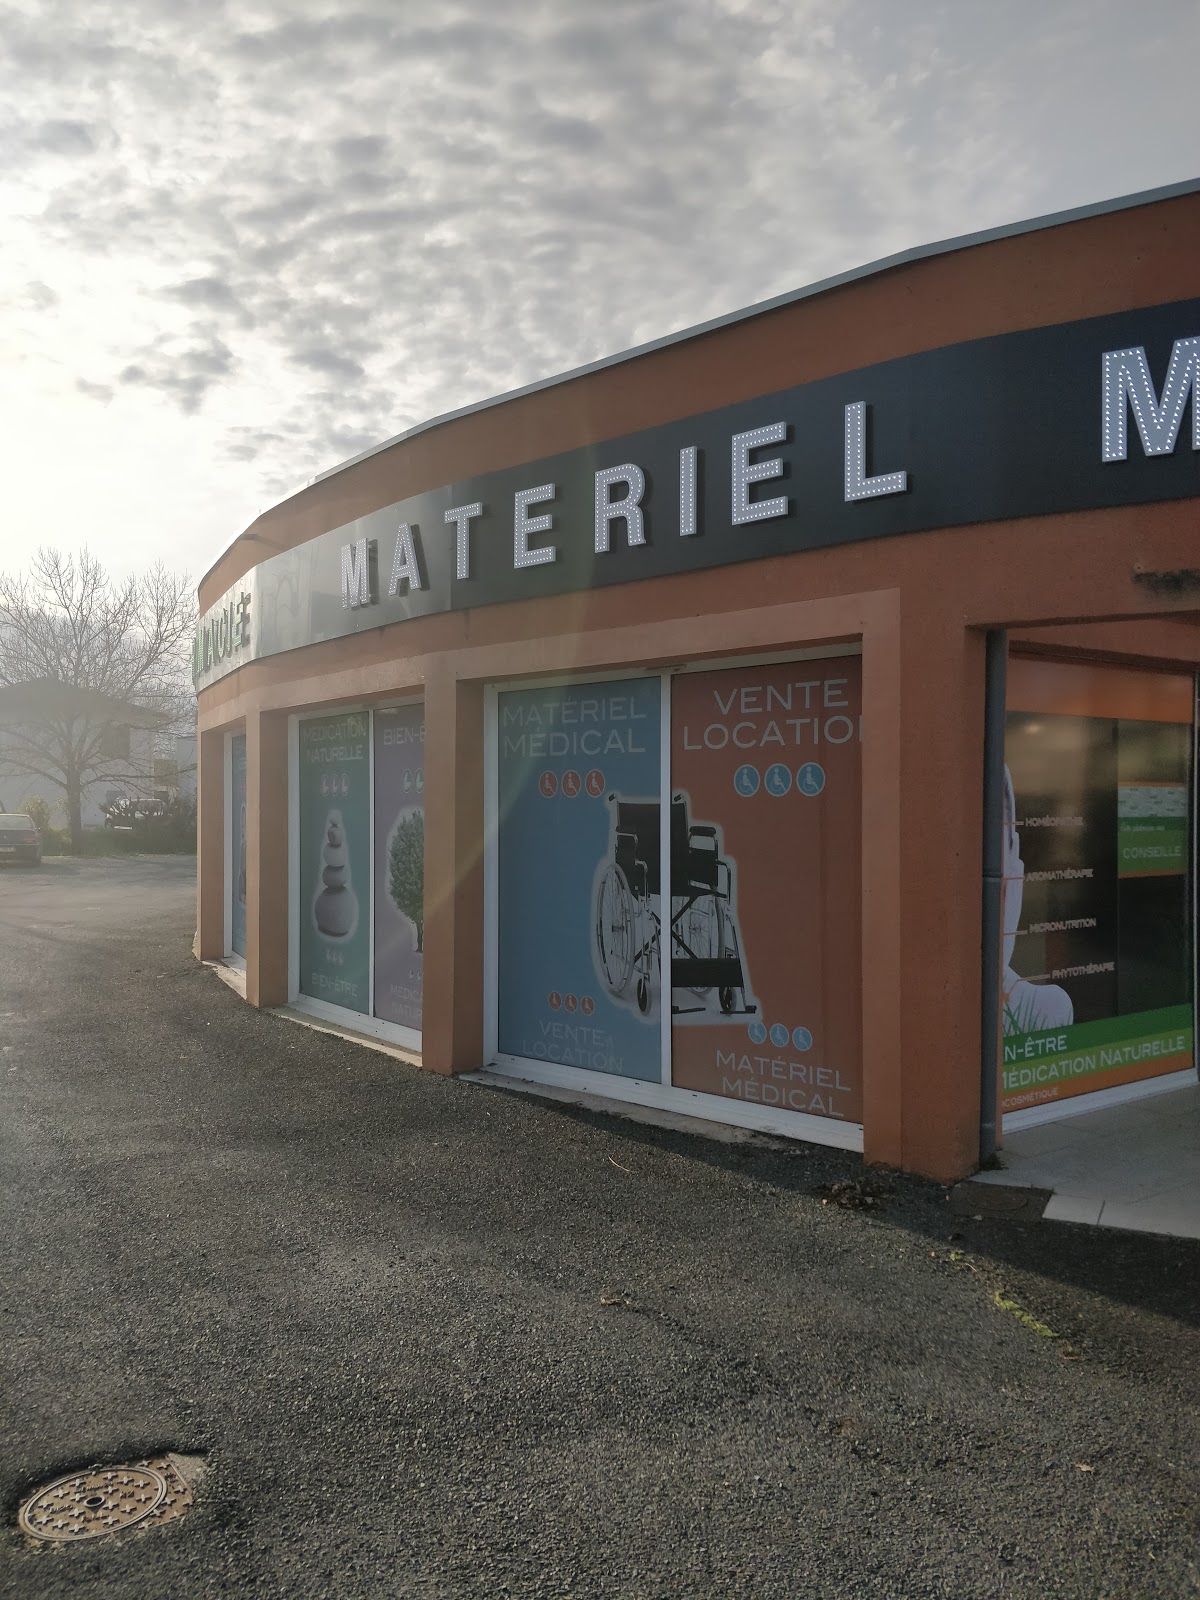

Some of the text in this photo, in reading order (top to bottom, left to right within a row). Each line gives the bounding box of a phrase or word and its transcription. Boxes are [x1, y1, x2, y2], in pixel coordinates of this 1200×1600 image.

[340, 401, 907, 609] MATERIEL
[503, 696, 647, 727] MATÉRIEL
[712, 678, 849, 715] VENTE
[503, 728, 646, 758] MÉDICAL
[683, 714, 863, 751] LOCATIO
[306, 745, 364, 763] NATURELLE
[1122, 845, 1182, 859] CONSEILLE
[1026, 867, 1094, 881] AROMATHÉRAPIE
[1029, 918, 1097, 934] MICRONUTRITION
[1052, 961, 1115, 979] PHYTOTHÉRAPIE
[539, 1018, 606, 1047] VENTE
[523, 1039, 624, 1073] LOCATION
[716, 1049, 852, 1092] MATÉRIEL
[1002, 1035, 1185, 1090] ÉDICATION NATURELLE
[722, 1076, 845, 1118] MÉDICAL
[1002, 1087, 1059, 1108] COSMÉTIQUE
